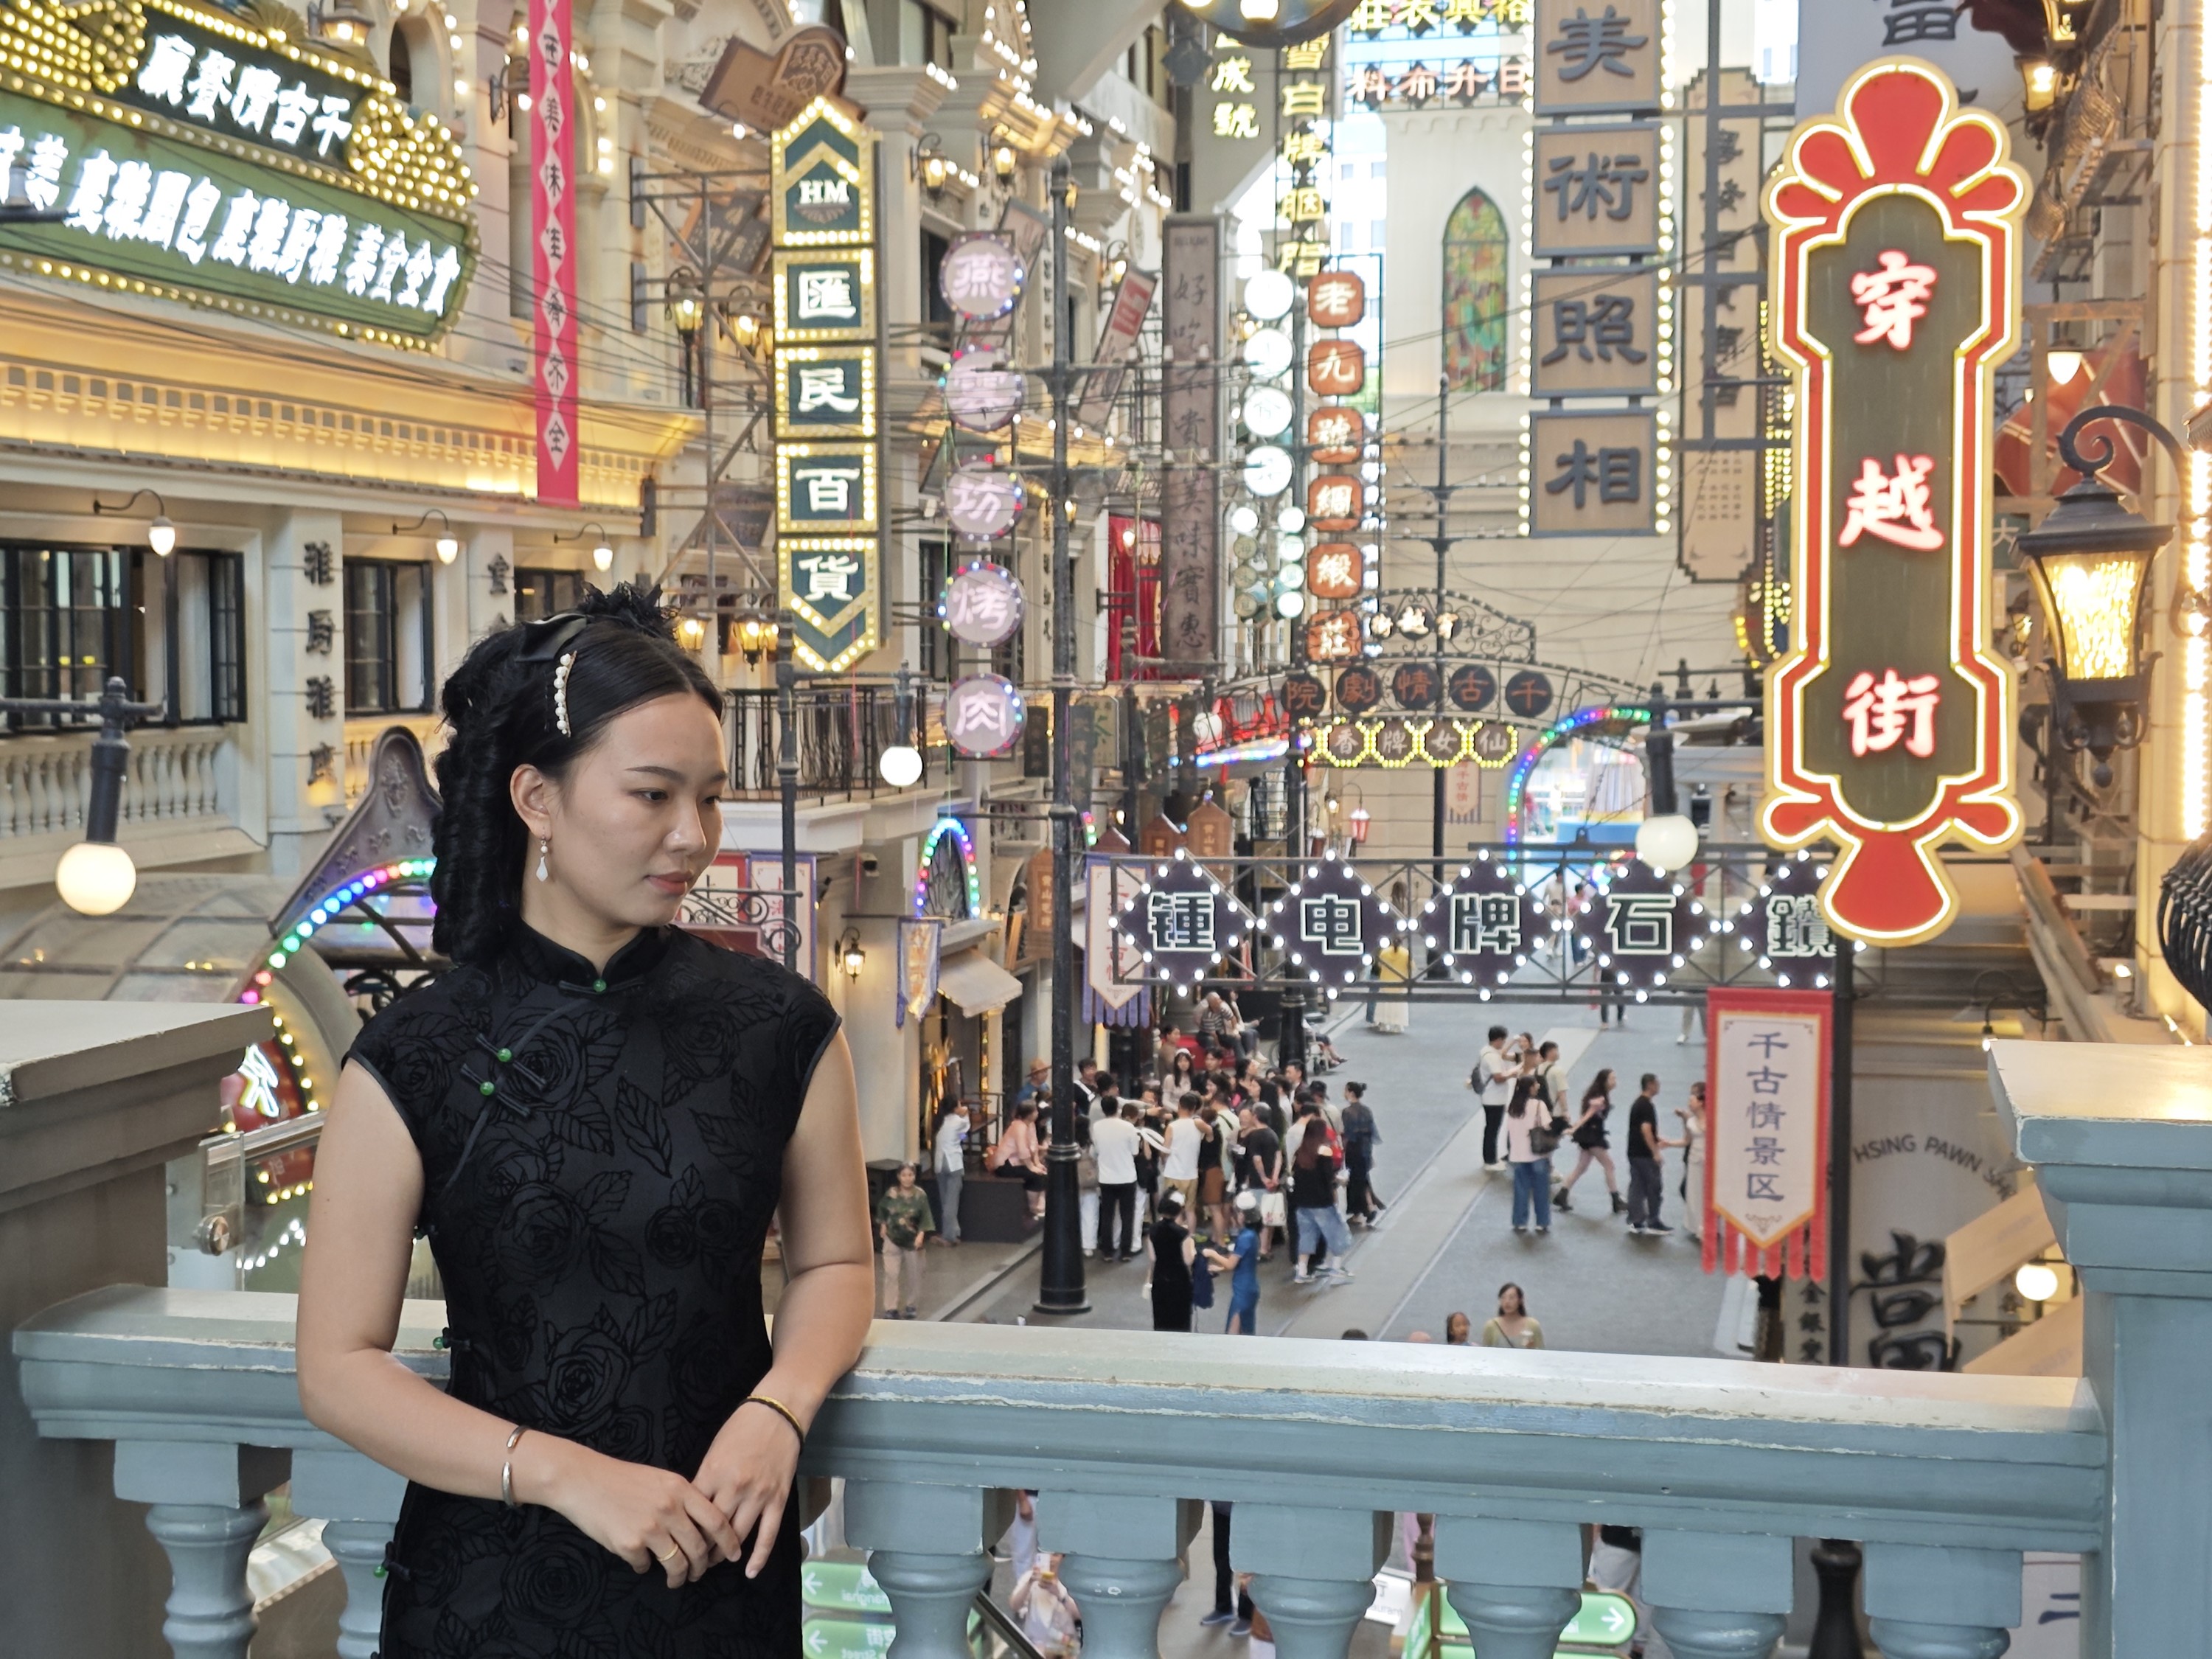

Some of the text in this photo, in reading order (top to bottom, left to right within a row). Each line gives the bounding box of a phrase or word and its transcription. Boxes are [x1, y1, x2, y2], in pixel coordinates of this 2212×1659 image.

[798, 180, 849, 204] HM
[1541, 7, 1649, 510] 美術照相
[796, 271, 860, 602] 匯民百貨
[1839, 250, 1944, 759] 穿越街
[1745, 1032, 1788, 1203] 千古情景区
[1853, 1134, 1916, 1163] HSING
[1924, 1136, 1983, 1172] PAWN
